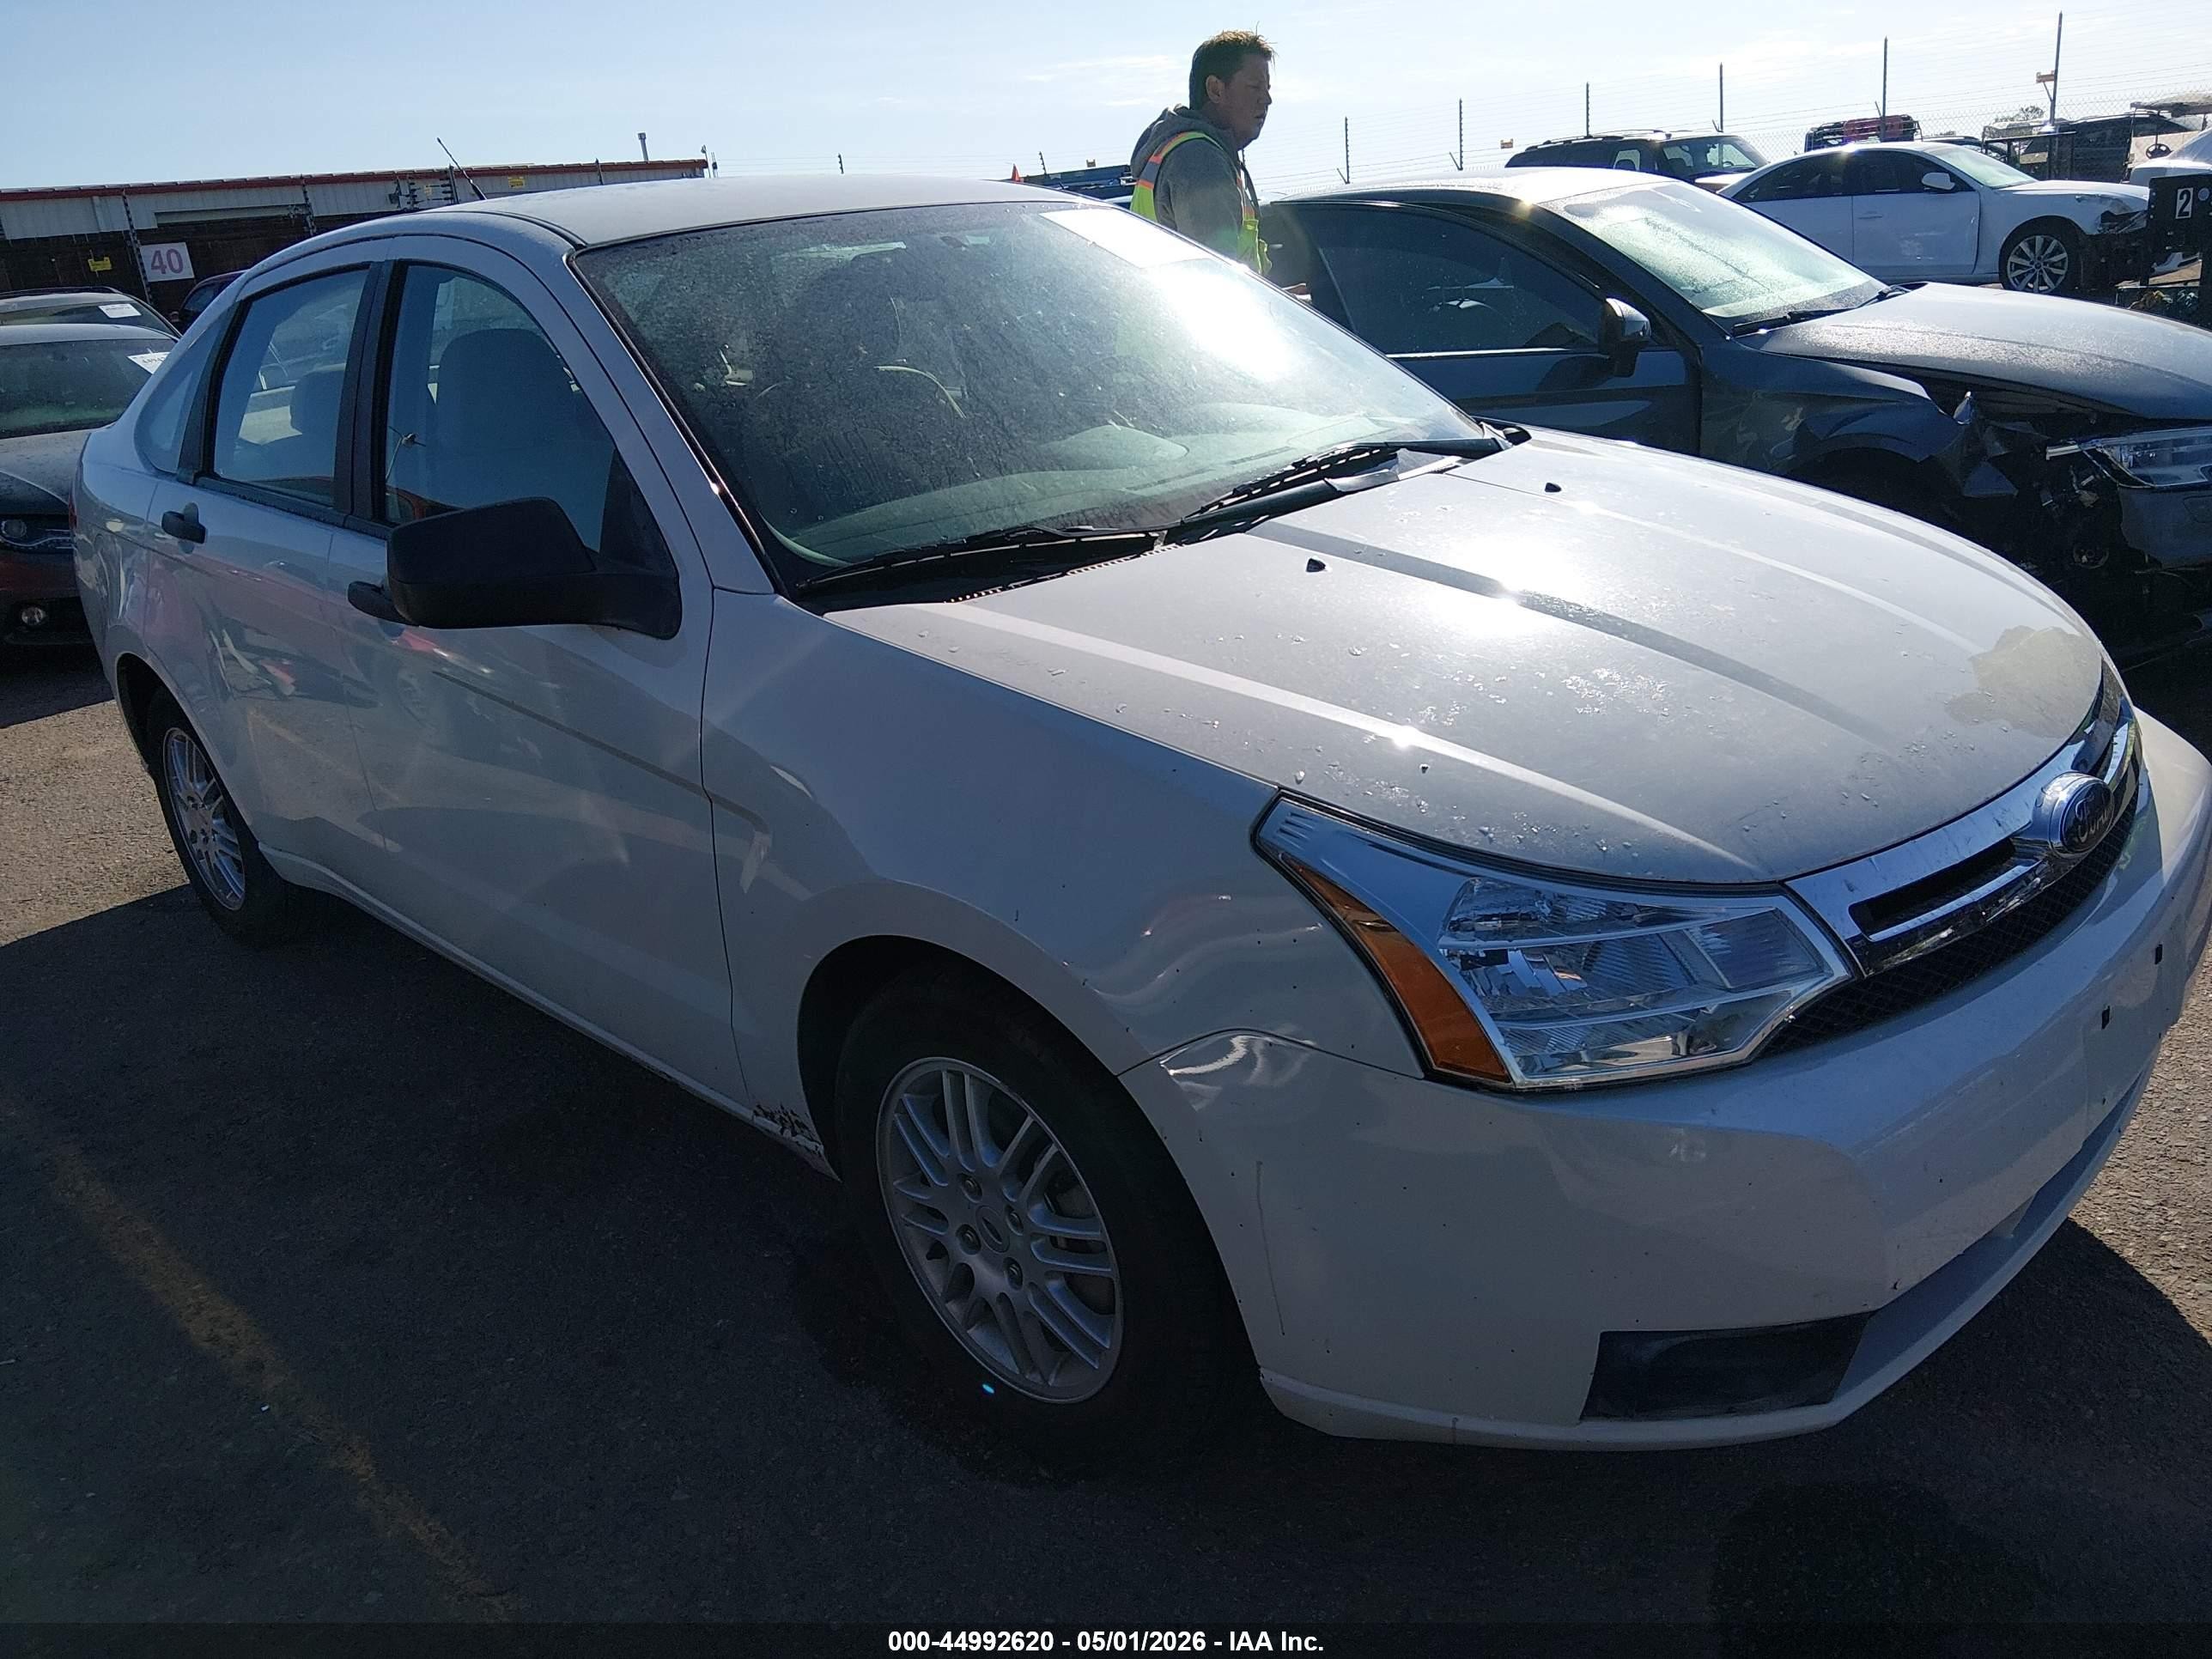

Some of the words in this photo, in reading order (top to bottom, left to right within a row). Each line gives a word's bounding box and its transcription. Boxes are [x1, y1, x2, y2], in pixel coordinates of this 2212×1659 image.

[2177, 189, 2191, 217] 2
[151, 248, 184, 275] 40
[2074, 793, 2111, 843] Ford
